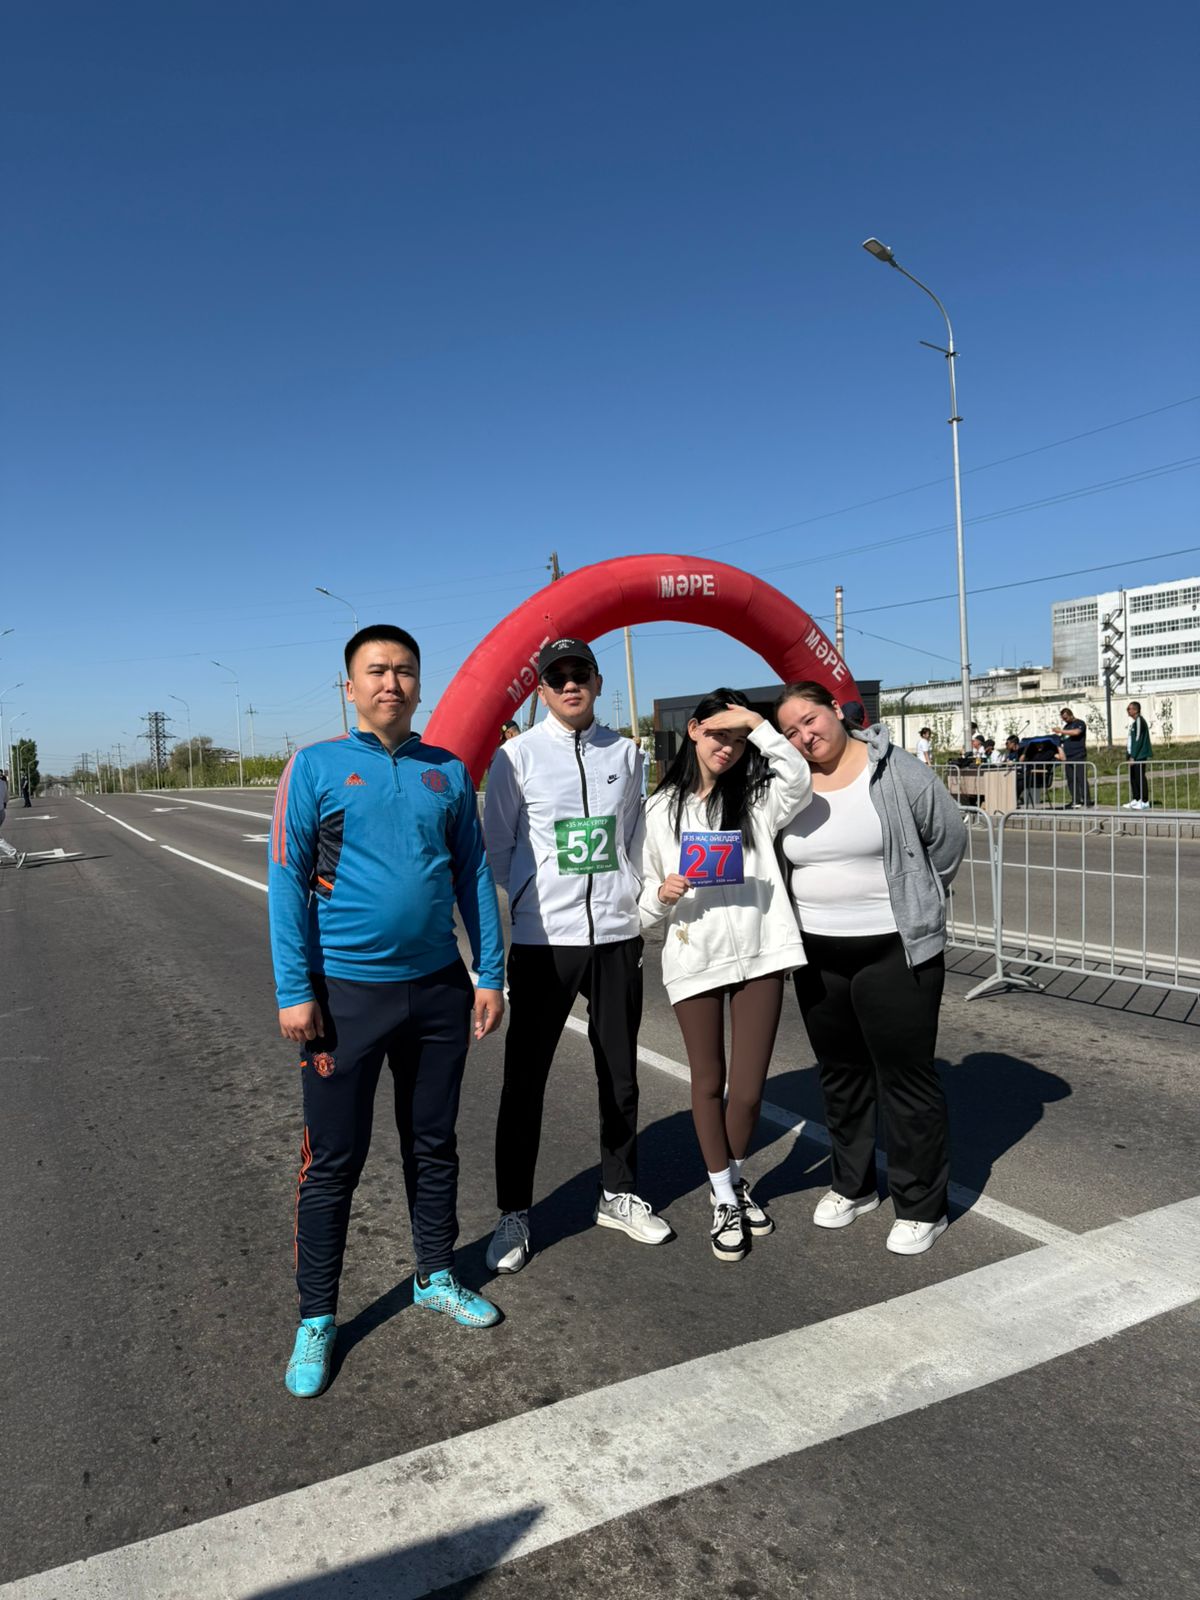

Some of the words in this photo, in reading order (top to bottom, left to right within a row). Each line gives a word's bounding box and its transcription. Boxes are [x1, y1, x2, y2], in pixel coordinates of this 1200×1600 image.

[660, 574, 715, 598] МӘРЕ
[805, 628, 848, 682] МӘРЕ
[567, 827, 609, 864] 52
[684, 843, 734, 879] 27
